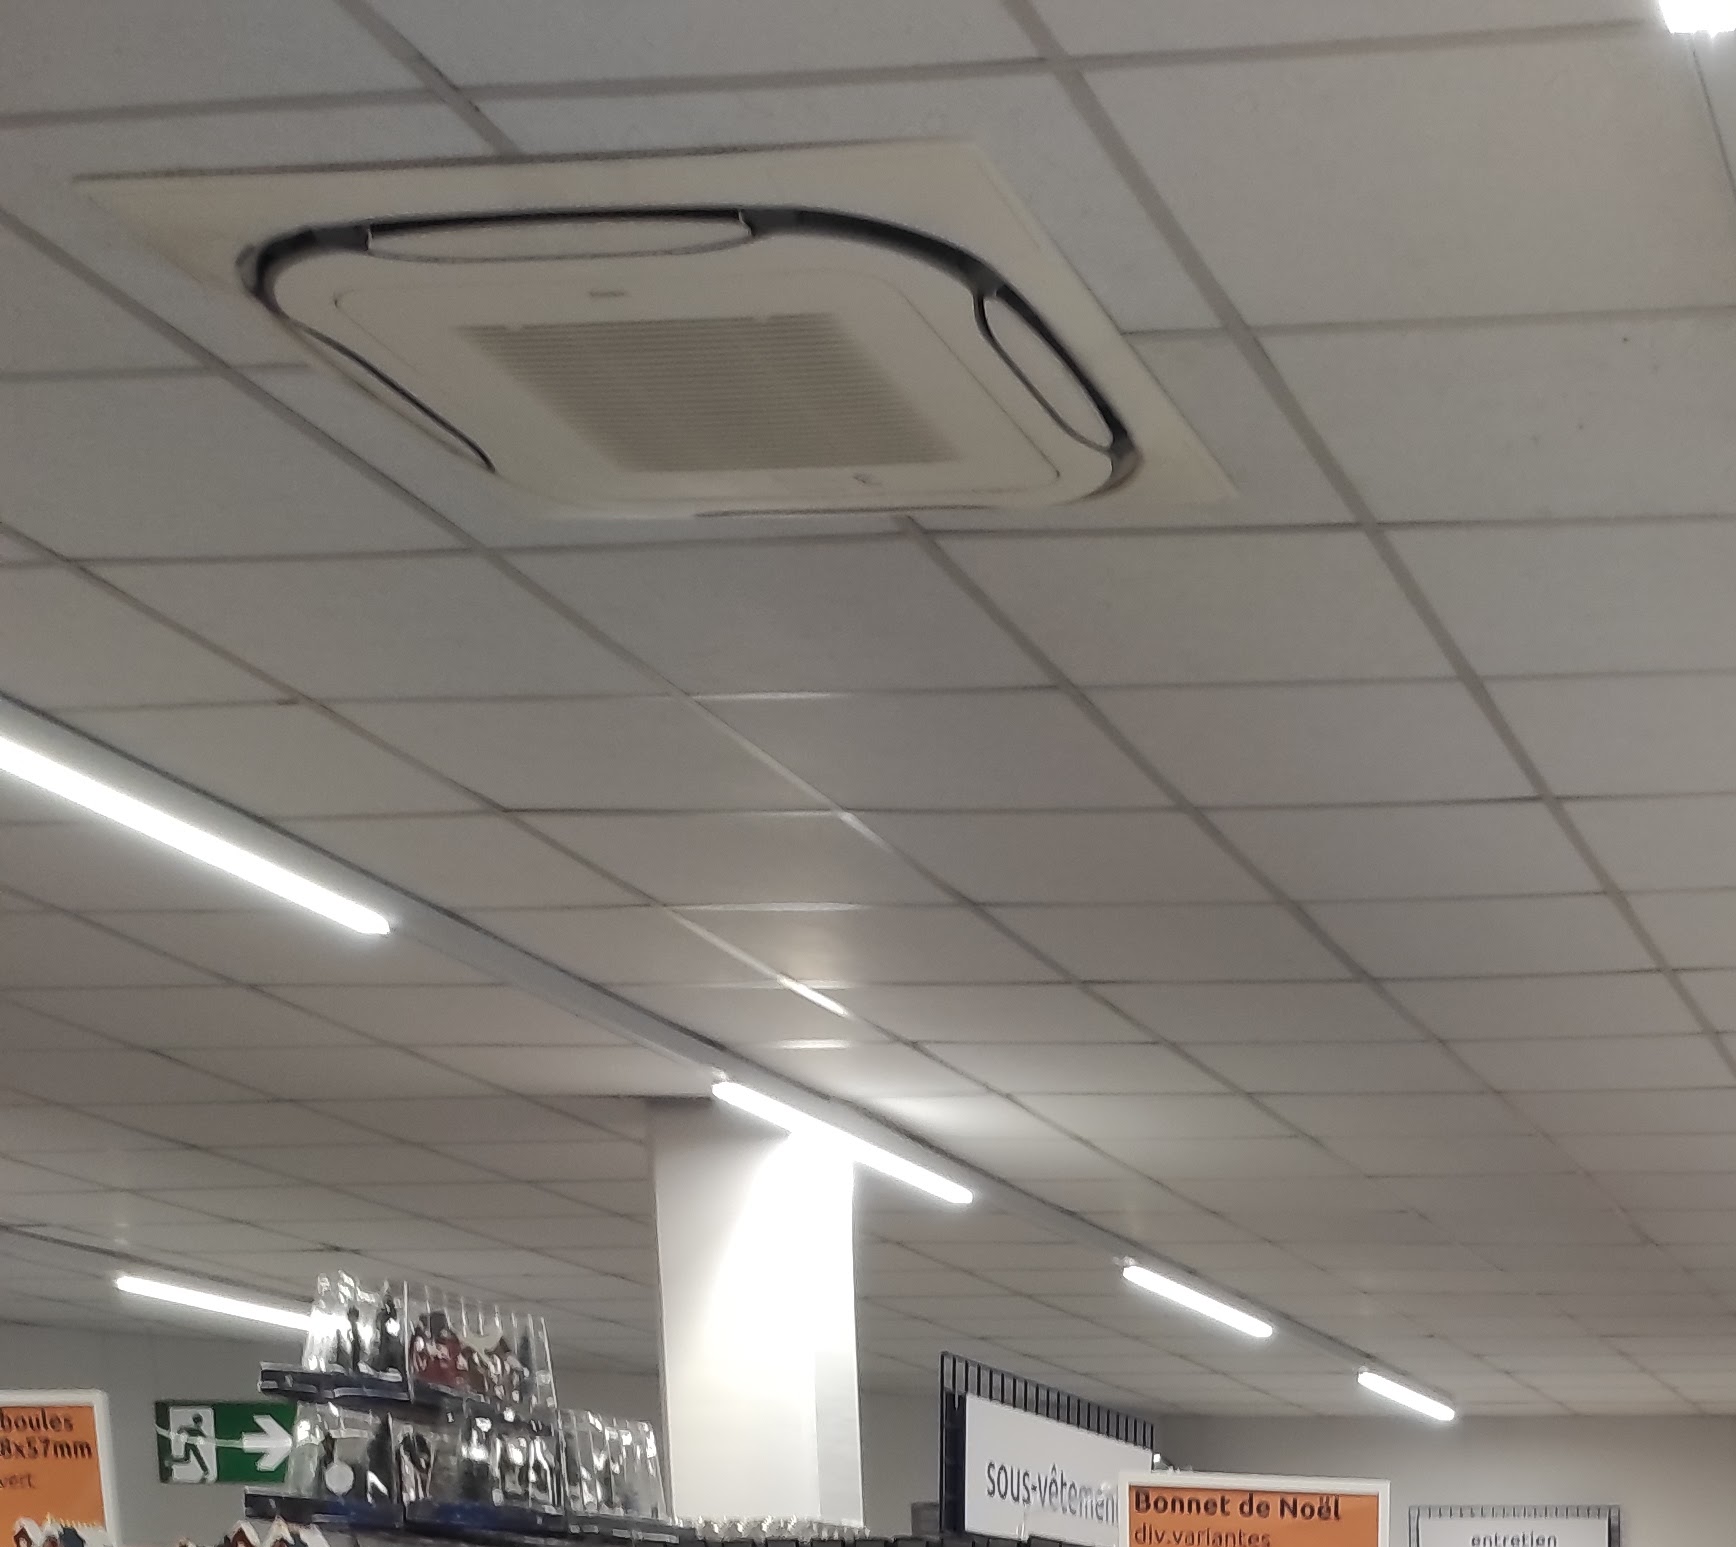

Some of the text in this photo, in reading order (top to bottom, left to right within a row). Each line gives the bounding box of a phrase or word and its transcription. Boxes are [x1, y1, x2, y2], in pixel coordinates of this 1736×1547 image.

[1134, 1490, 1340, 1521] Bonnet de Noël
